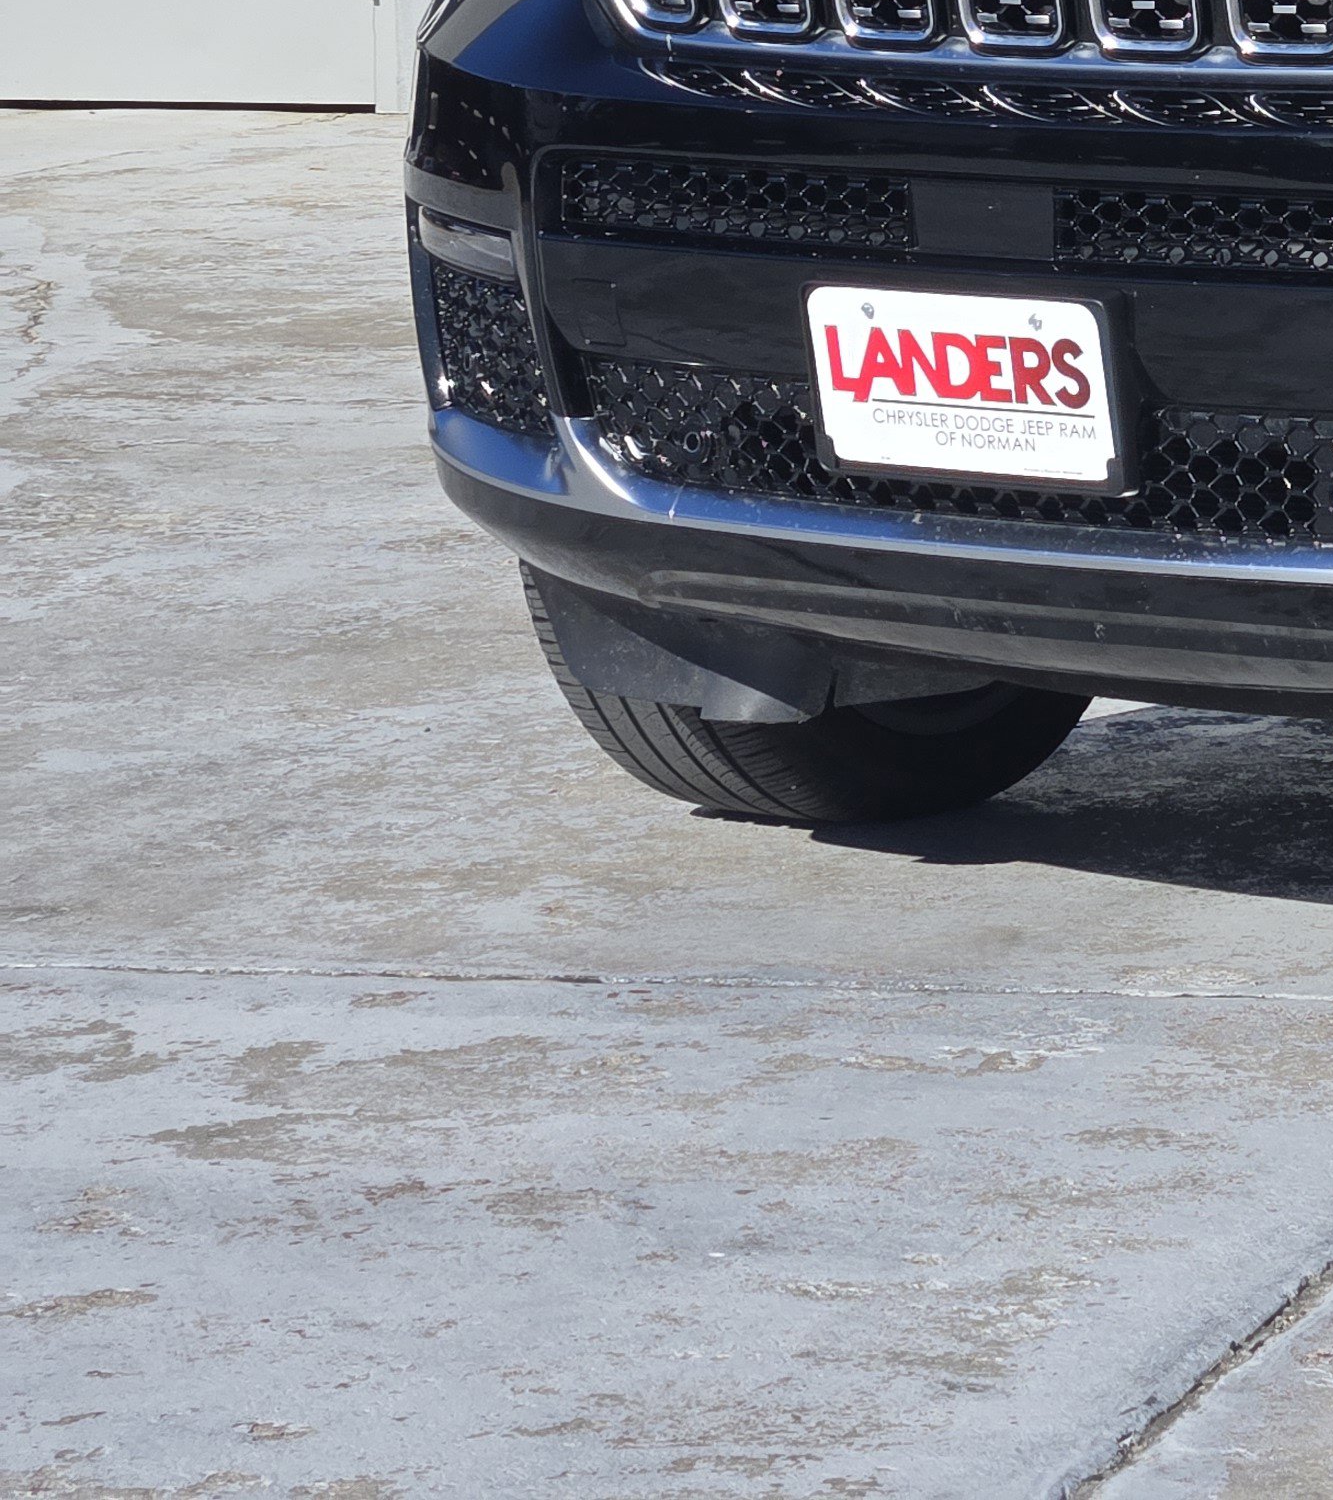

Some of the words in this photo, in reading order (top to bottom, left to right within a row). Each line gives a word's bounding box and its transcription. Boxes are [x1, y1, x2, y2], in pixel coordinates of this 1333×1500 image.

[824, 324, 1091, 409] LANDERS
[872, 408, 949, 429] CHRYSLER
[953, 414, 1014, 435] DODGE
[1020, 419, 1054, 437] JEEP
[1058, 422, 1097, 440] RAM
[935, 430, 958, 446] OF
[961, 433, 1036, 452] NORMAN
